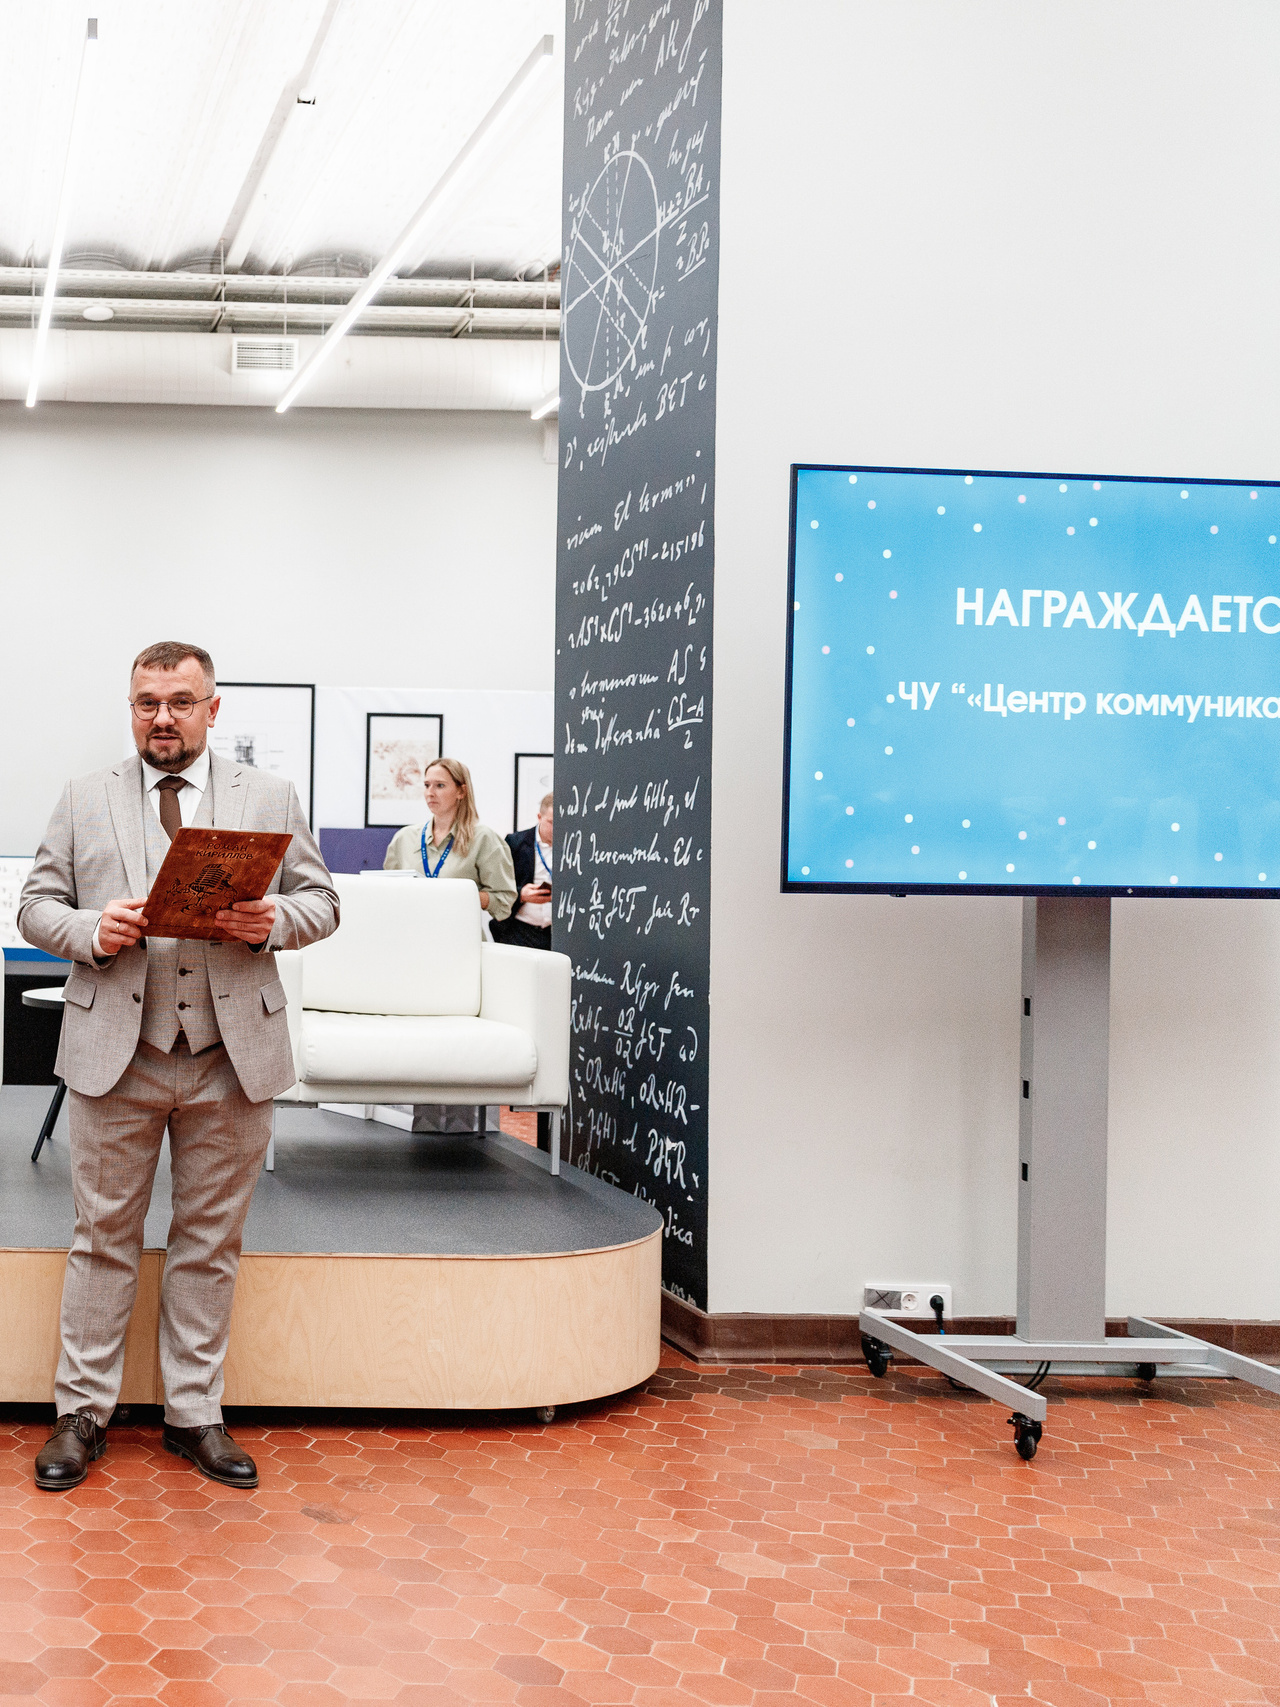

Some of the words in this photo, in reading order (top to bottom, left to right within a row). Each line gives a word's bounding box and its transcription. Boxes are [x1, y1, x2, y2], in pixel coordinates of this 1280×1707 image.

[956, 587, 1280, 638] НАГРАЖДАЕТС
[898, 681, 941, 711] ЧУ
[195, 850, 254, 860] КИРИЛЛОВ
[207, 842, 249, 852] РОМАН
